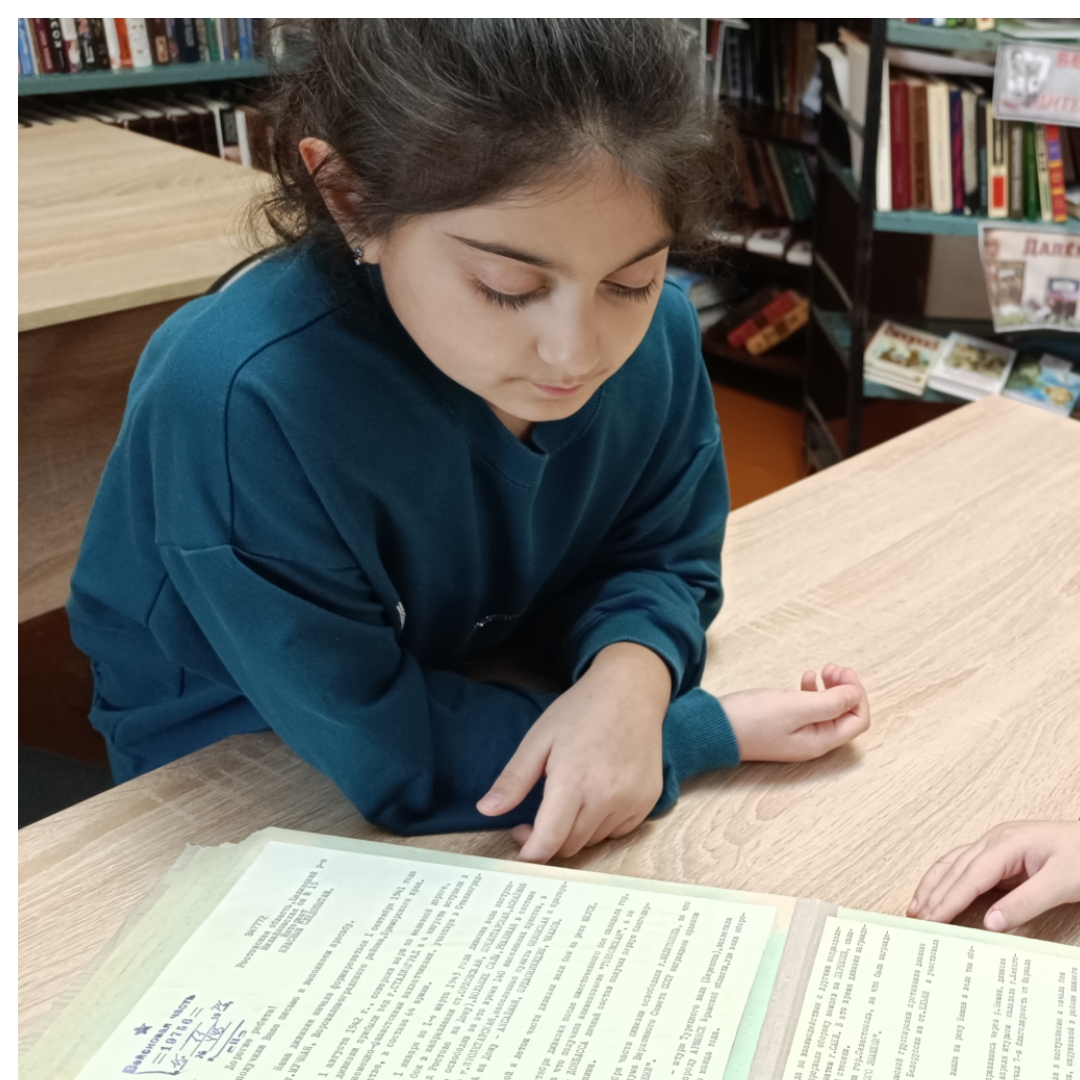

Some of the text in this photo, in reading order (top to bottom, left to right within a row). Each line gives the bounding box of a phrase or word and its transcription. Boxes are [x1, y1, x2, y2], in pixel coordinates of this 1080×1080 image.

[167, 993, 197, 1020] часть
[398, 952, 473, 1068] января марта года
[512, 1036, 531, 1060] летом
[524, 1013, 542, 1035] части
[573, 923, 587, 939] реке
[583, 1011, 602, 1037] личный
[595, 984, 614, 1010] состав
[160, 1018, 193, 1052] 19756
[223, 1004, 278, 1070] Дорогие ребята!
[233, 1043, 268, 1080] получили
[261, 1022, 282, 1041] Ваше
[276, 995, 301, 1020] письмо
[272, 1051, 294, 1071] Наша
[288, 1018, 316, 1049] дивизия
[310, 991, 335, 1016] начала
[384, 1017, 410, 1048] составе
[442, 1034, 471, 1074] освободив
[481, 984, 499, 1005] время
[546, 1023, 567, 1054] дивизия
[560, 1001, 577, 1022] после
[632, 1018, 657, 1061] Верховного
[650, 991, 667, 1017] Совета
[660, 973, 674, 990] СССР
[679, 1003, 701, 1041] Турецкого
[323, 1036, 352, 1068] августа
[333, 1046, 361, 1079] дивизии
[354, 1014, 381, 1044] прибыли
[407, 1063, 424, 1079] бои
[427, 1040, 452, 1071] Ростова
[480, 1042, 499, 1061] Дону
[552, 1058, 566, 1073] что
[560, 1021, 583, 1056] получила
[617, 1040, 633, 1063] части
[671, 1042, 688, 1066] штурм
[698, 1050, 713, 1074] конца
[707, 1026, 721, 1047] года.
